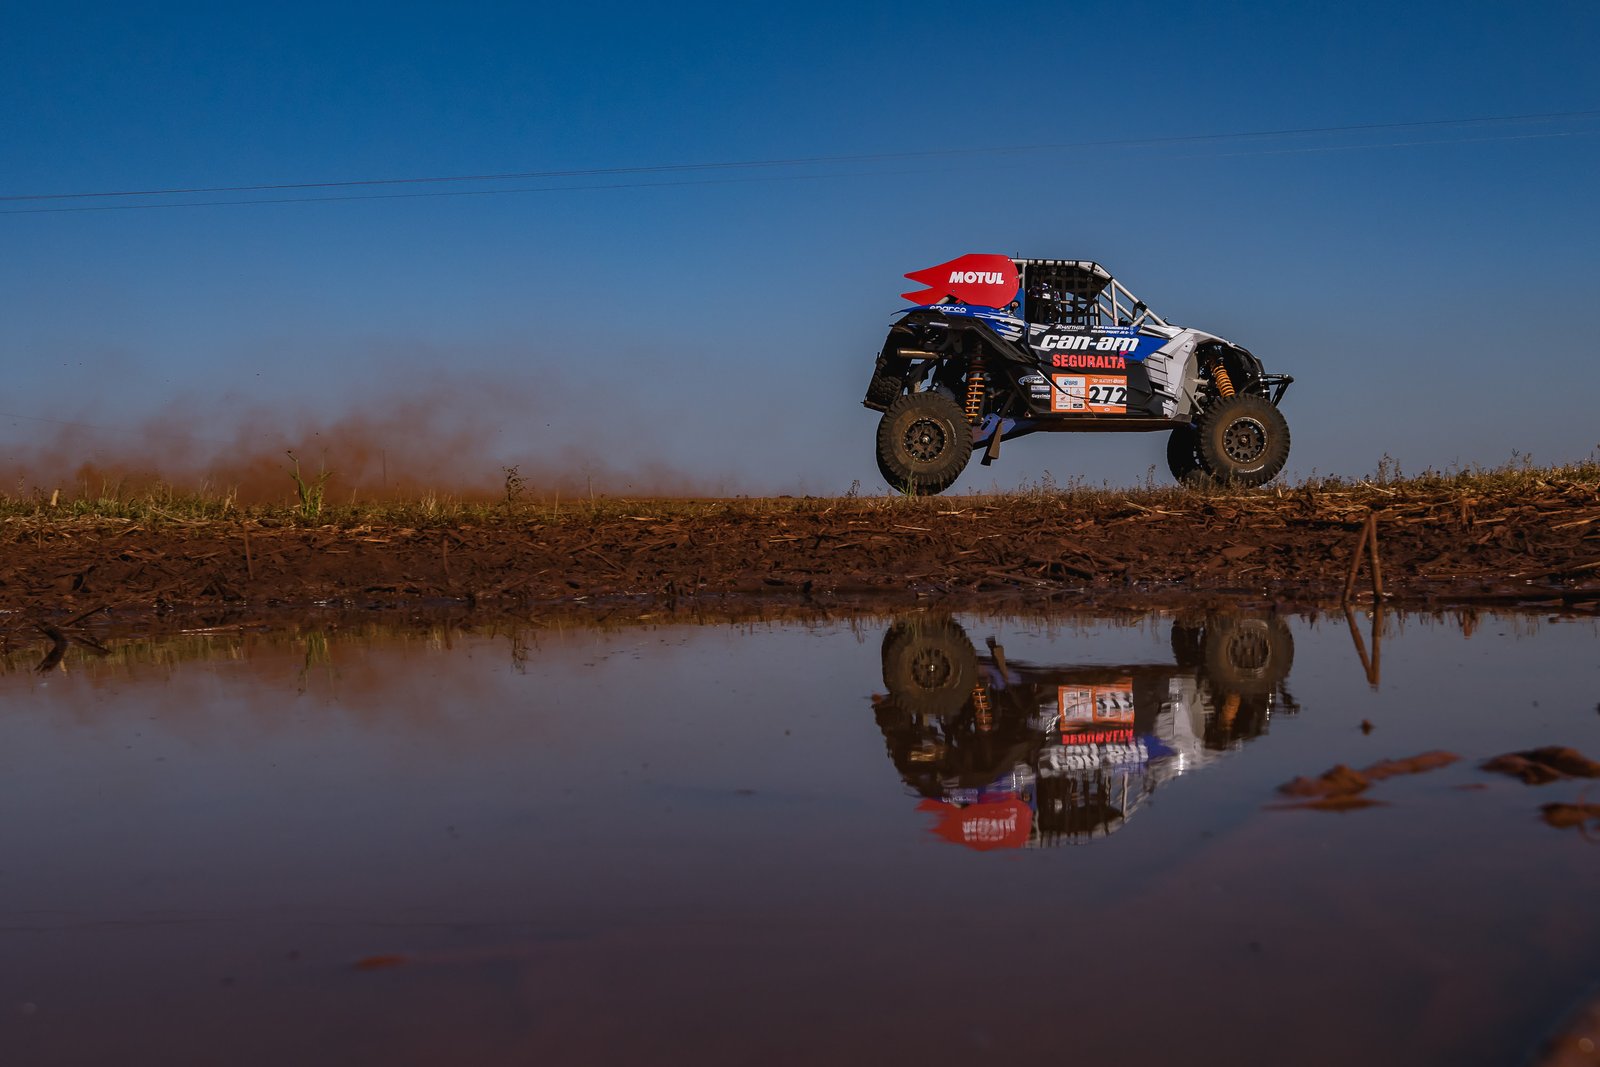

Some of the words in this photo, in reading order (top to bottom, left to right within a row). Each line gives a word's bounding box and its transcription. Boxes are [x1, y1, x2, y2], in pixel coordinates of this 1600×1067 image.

[948, 271, 1005, 285] MOTUL
[1040, 334, 1140, 352] can-am
[1052, 353, 1127, 369] SEGURALTA
[1089, 385, 1128, 405] 272
